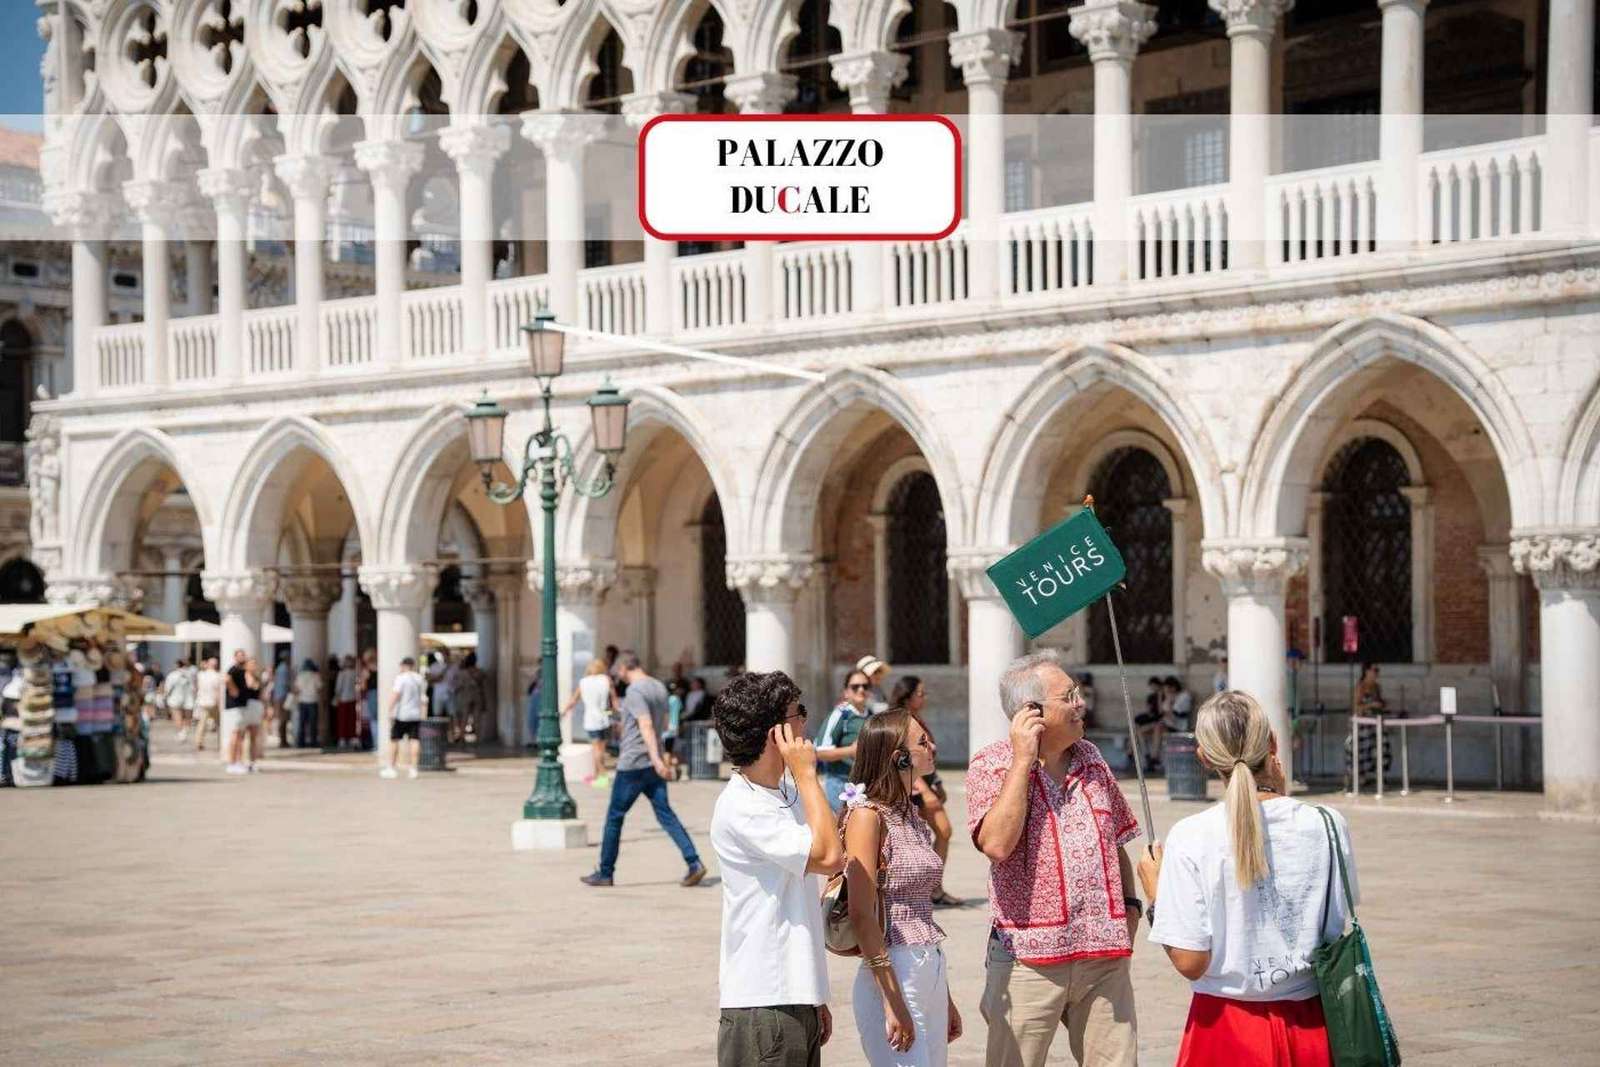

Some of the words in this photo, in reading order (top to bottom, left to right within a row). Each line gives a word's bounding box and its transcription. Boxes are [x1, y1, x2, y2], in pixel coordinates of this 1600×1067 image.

[1016, 536, 1093, 587] VENICE
[1022, 547, 1104, 605] TOURS
[1254, 953, 1306, 969] VENI
